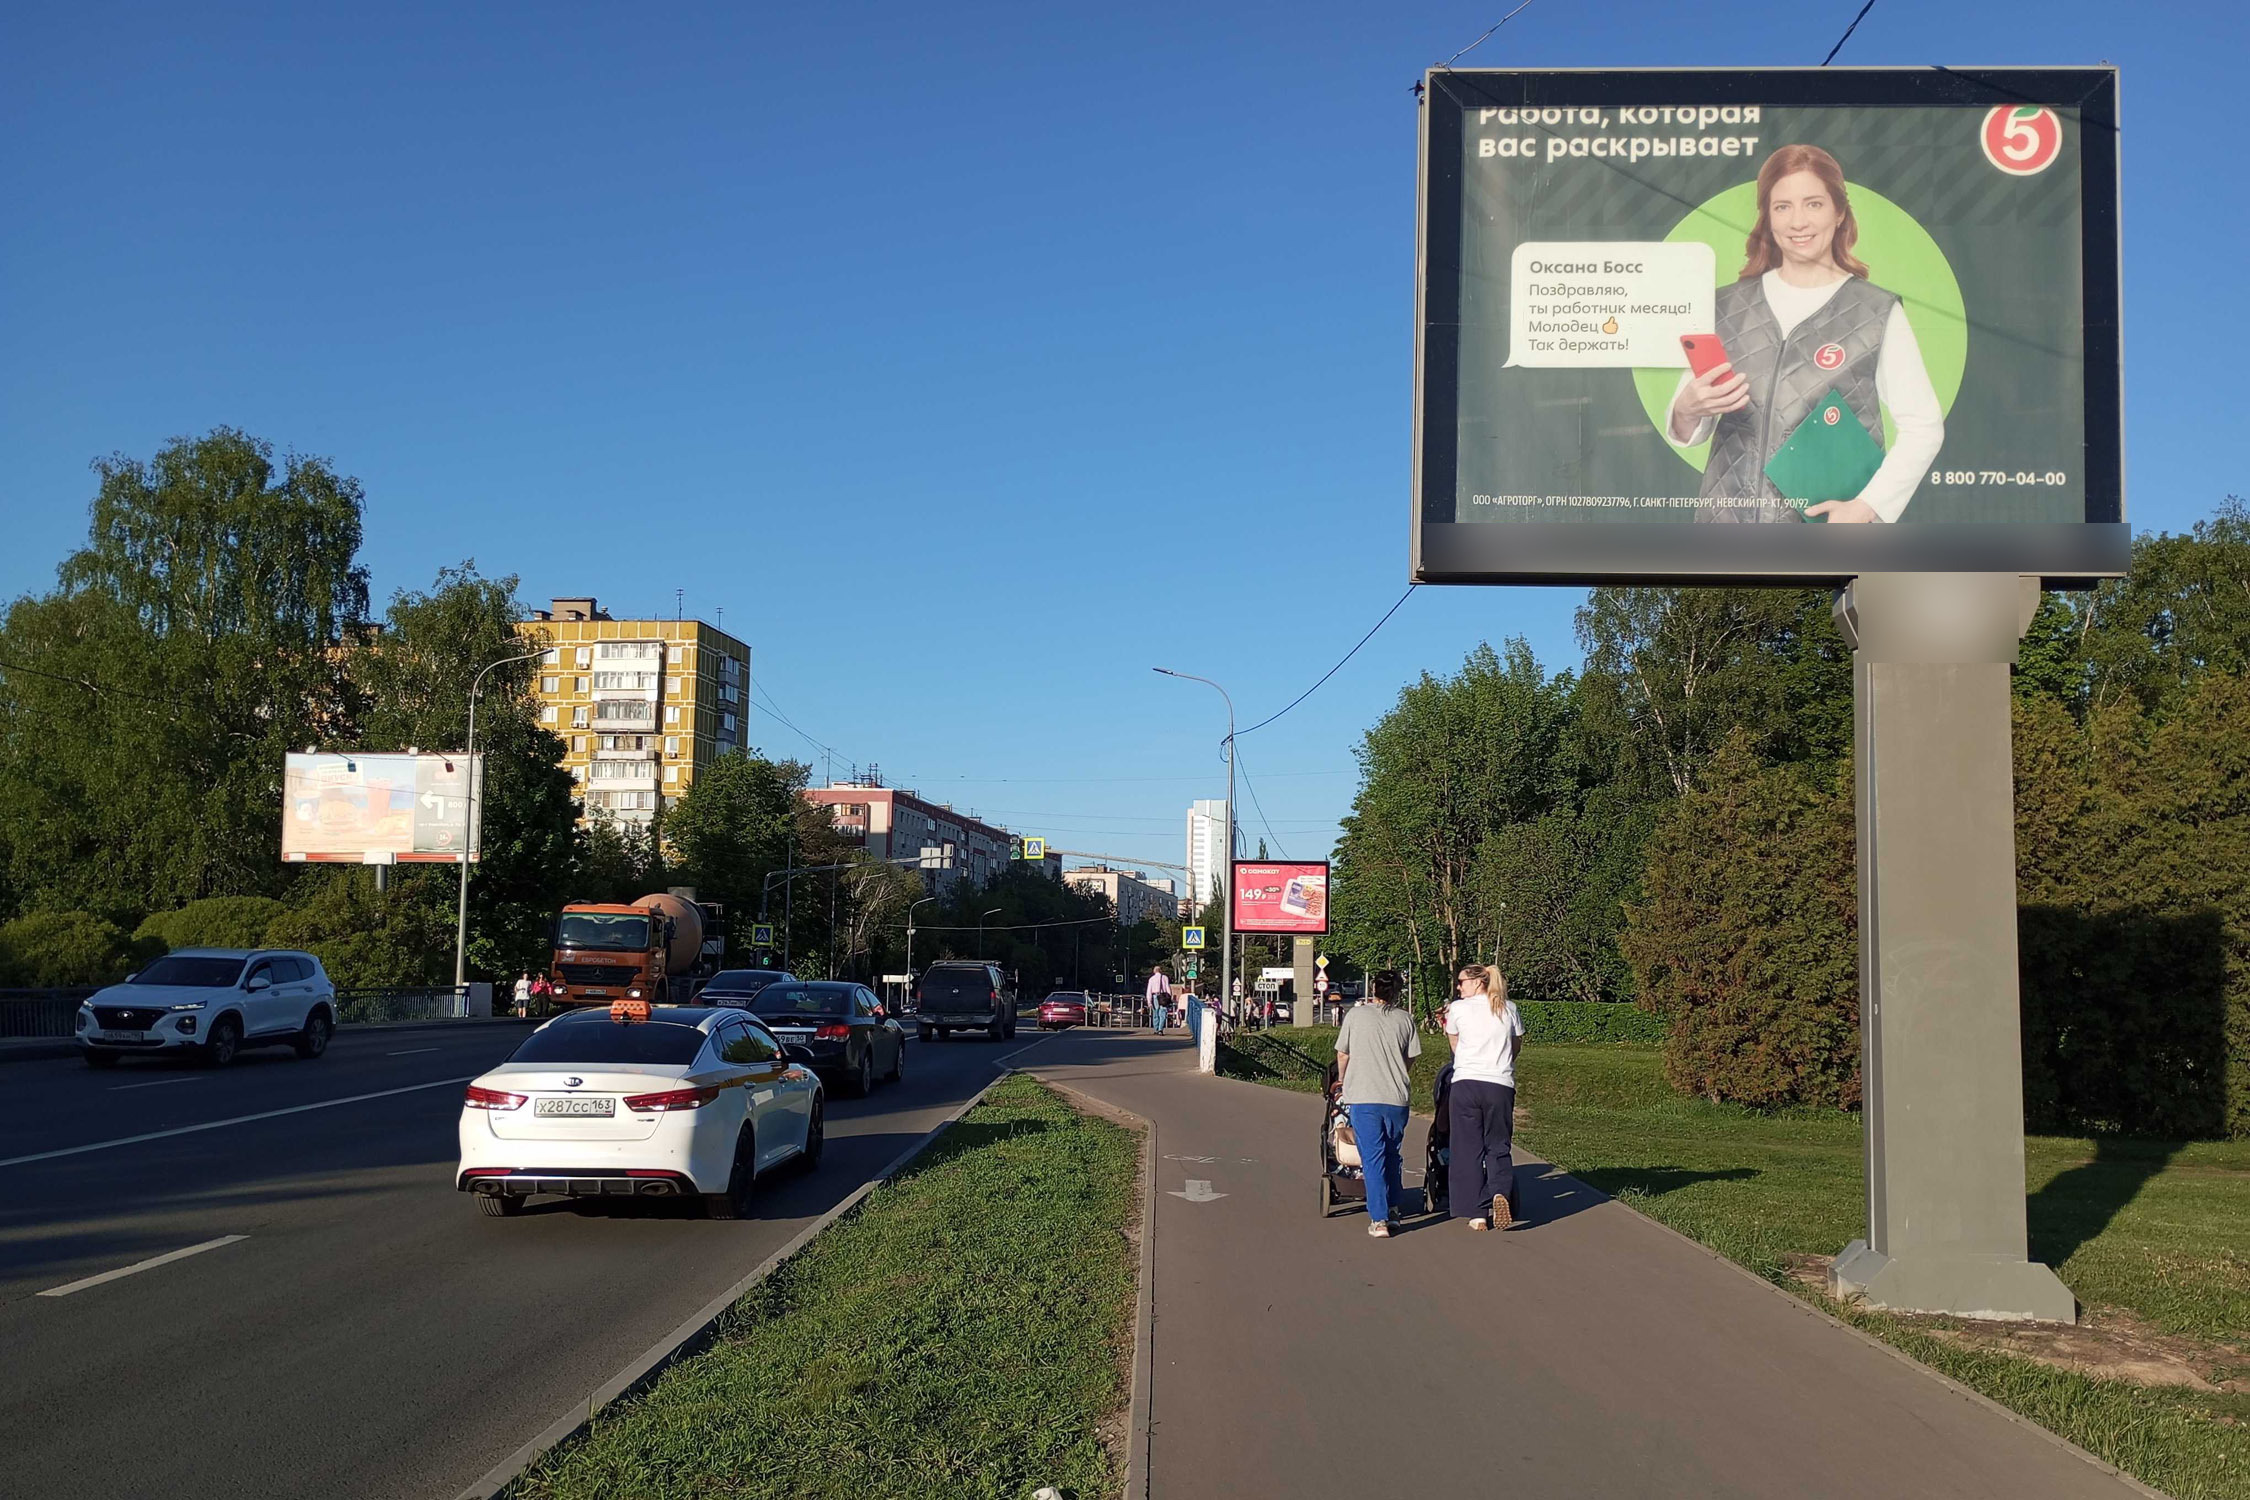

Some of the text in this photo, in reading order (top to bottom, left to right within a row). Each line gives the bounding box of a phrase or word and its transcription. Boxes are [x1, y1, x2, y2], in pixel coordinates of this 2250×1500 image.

[1479, 106, 1760, 130] Работа, которая
[1479, 136, 1759, 163] вас раскрывает
[1530, 260, 1644, 274] Оксана Босс
[1529, 283, 1629, 299] Поздравляю,
[1529, 302, 1692, 317] ты работник месяца!
[1528, 320, 1599, 335] Молодец
[1528, 338, 1629, 354] Так держать!
[1931, 471, 2066, 486] 8 800 770-04-00
[1472, 494, 1491, 505] ООО
[1492, 495, 1545, 508] «АГРОТОРГ»,
[1545, 495, 1567, 506] ОГРН
[1640, 497, 1716, 509] САНКТ-ПЕТЕРБУРГ,
[1717, 496, 1756, 508] НЕВСКИЙ
[592, 1100, 611, 1110] 163
